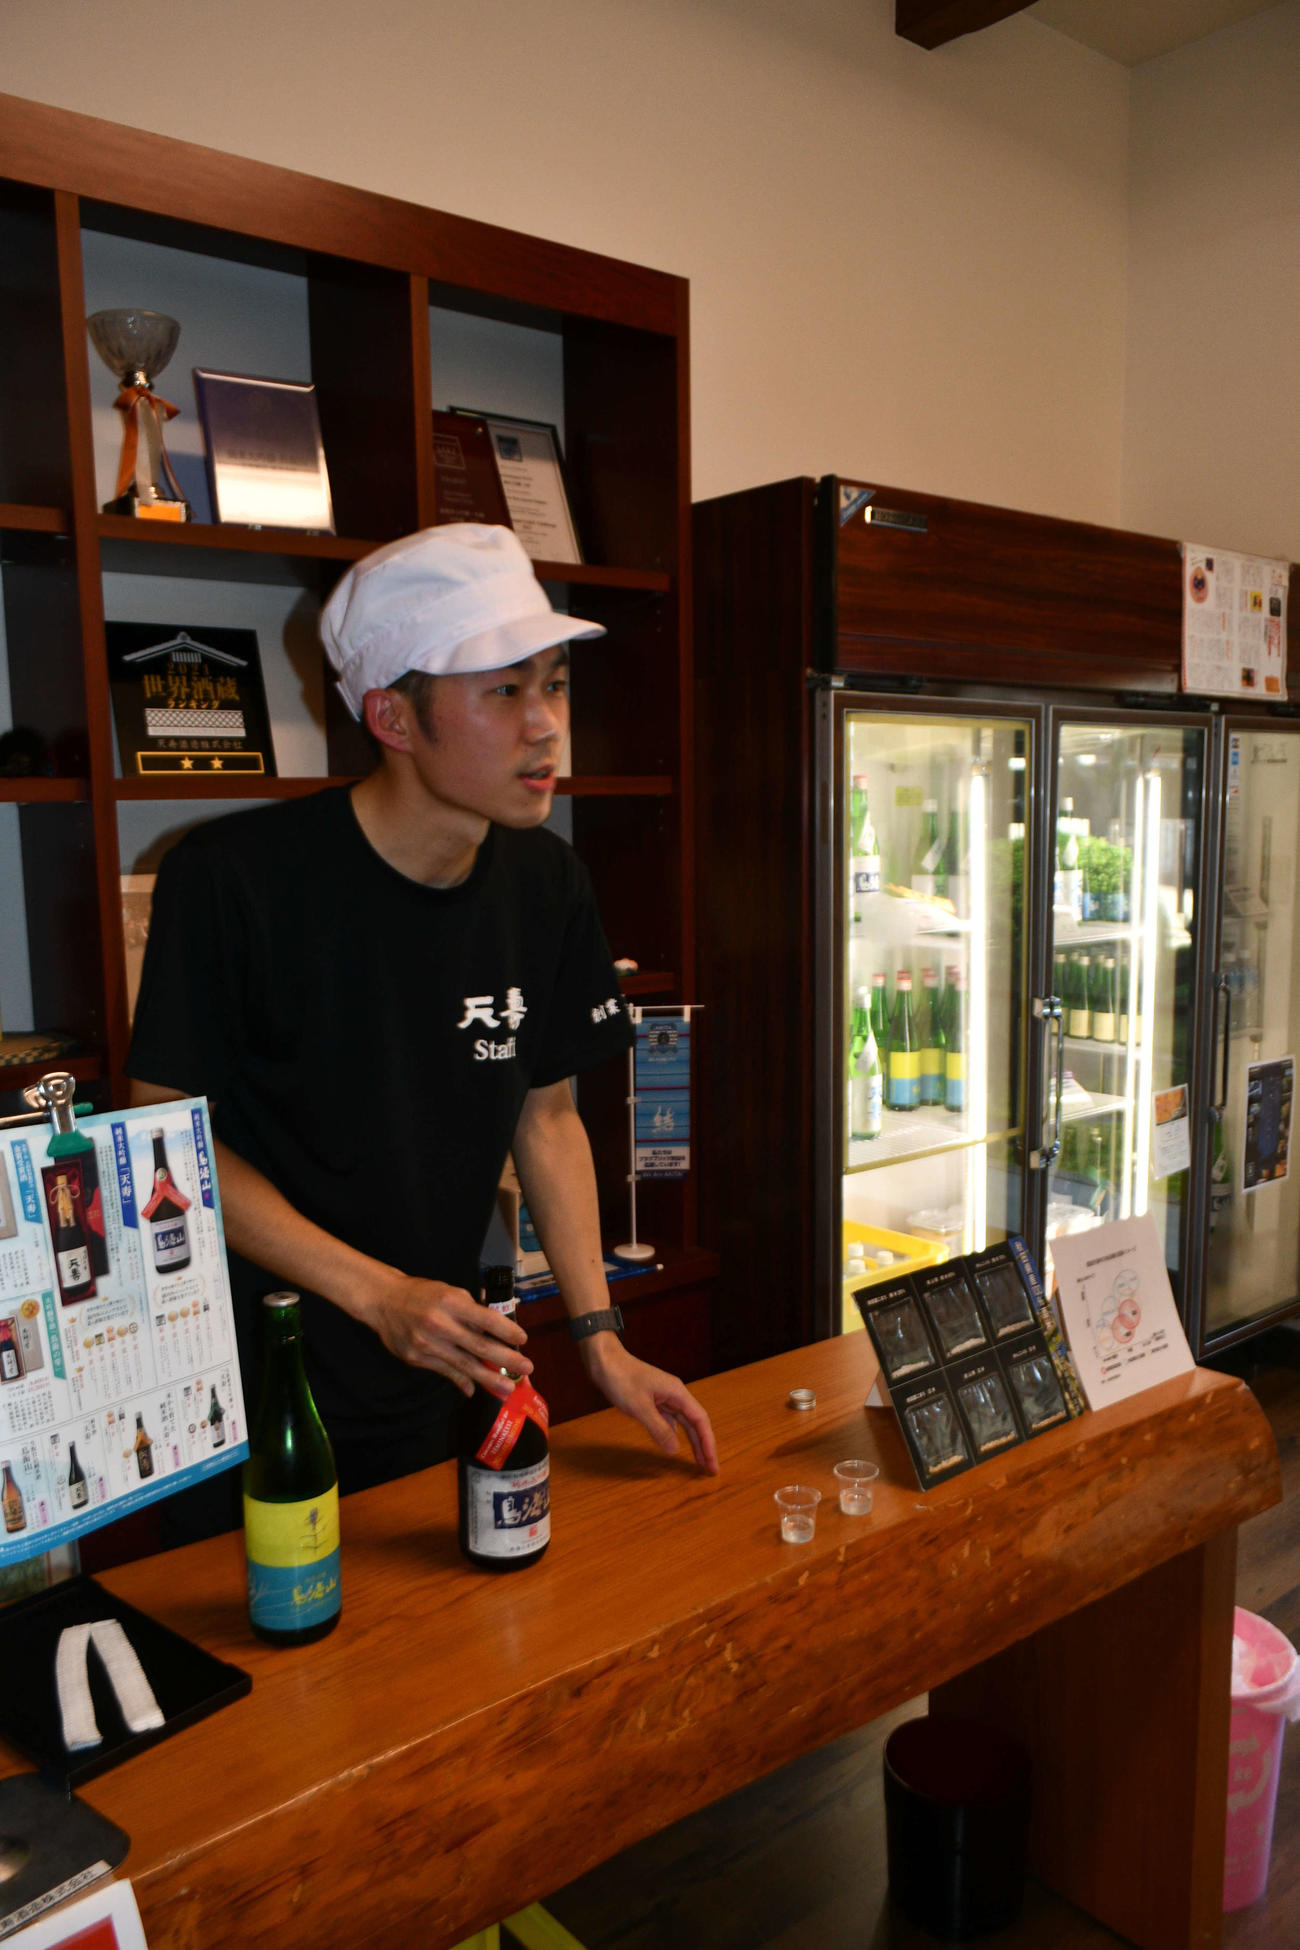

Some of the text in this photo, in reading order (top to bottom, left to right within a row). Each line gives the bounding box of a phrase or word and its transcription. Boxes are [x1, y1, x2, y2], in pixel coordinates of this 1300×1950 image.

[167, 699, 220, 709] ランキング
